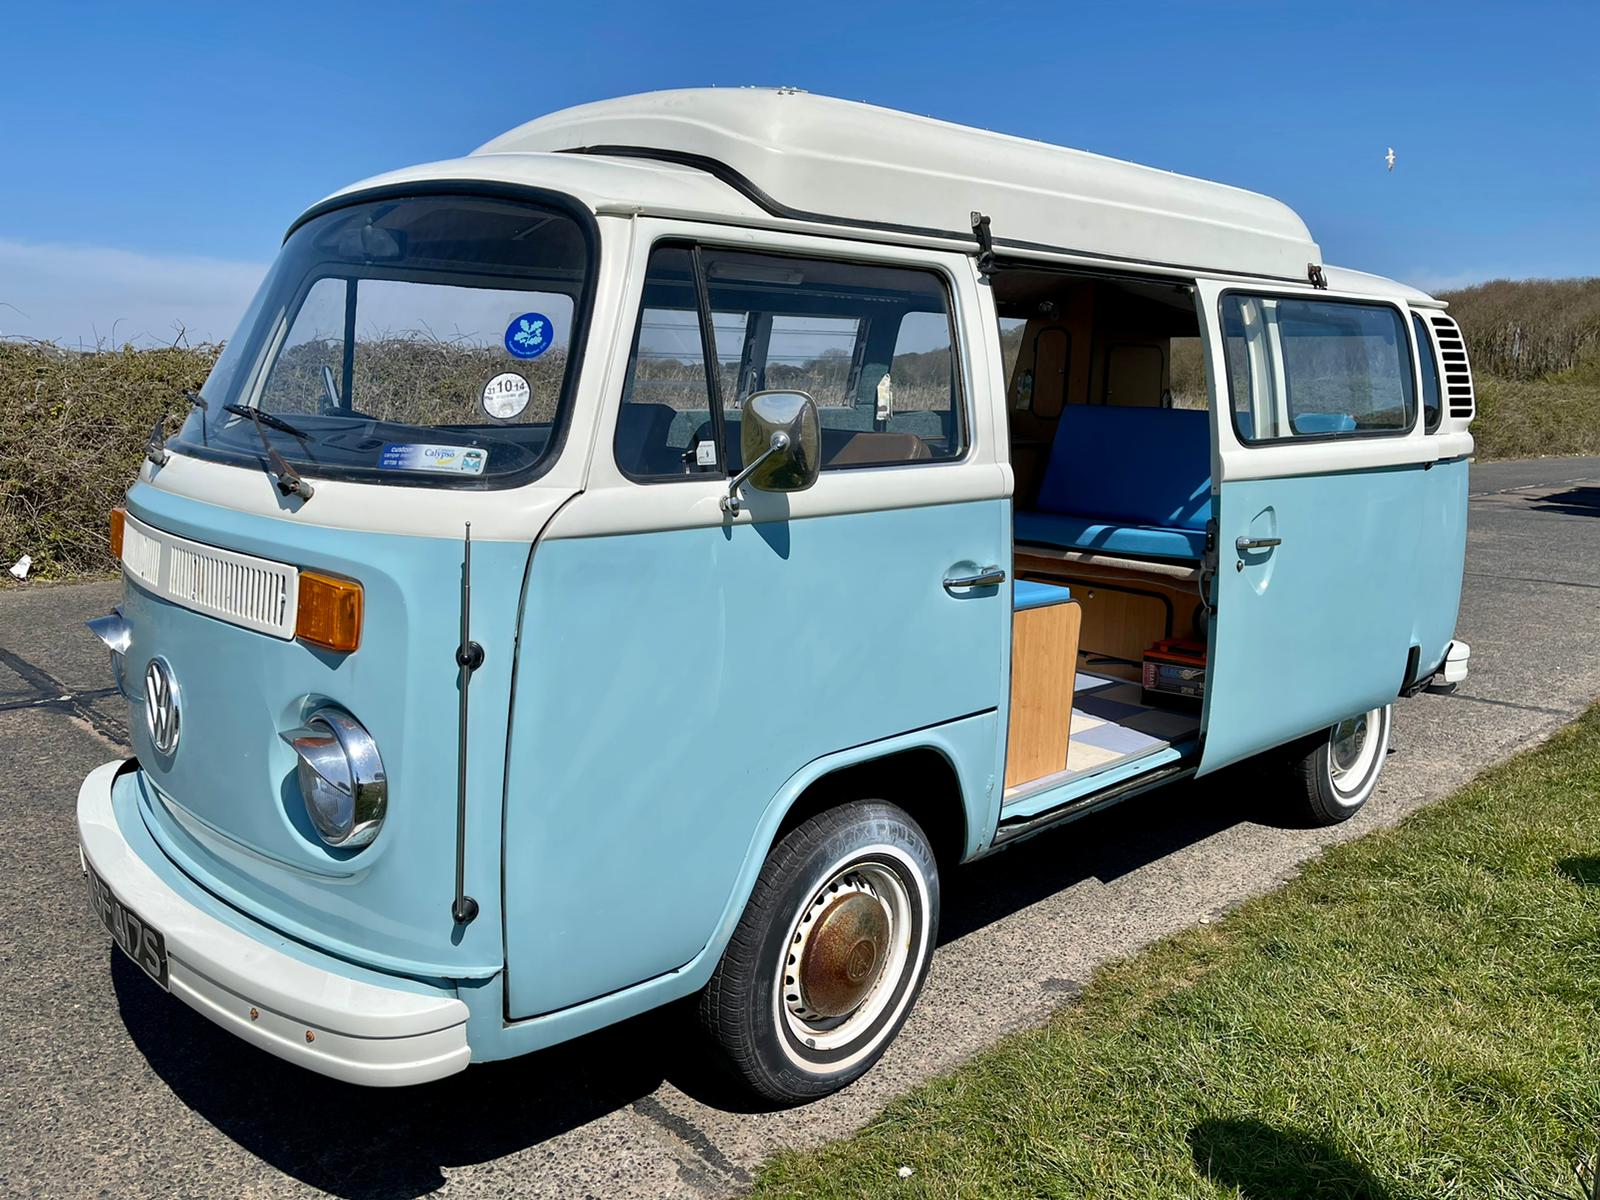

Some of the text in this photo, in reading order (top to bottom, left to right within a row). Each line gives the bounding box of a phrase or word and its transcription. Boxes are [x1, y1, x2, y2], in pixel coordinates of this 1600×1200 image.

[487, 387, 495, 395] 31
[497, 380, 512, 392] 10
[514, 382, 525, 391] 14
[425, 449, 455, 460] Calypso
[145, 660, 177, 752] VW
